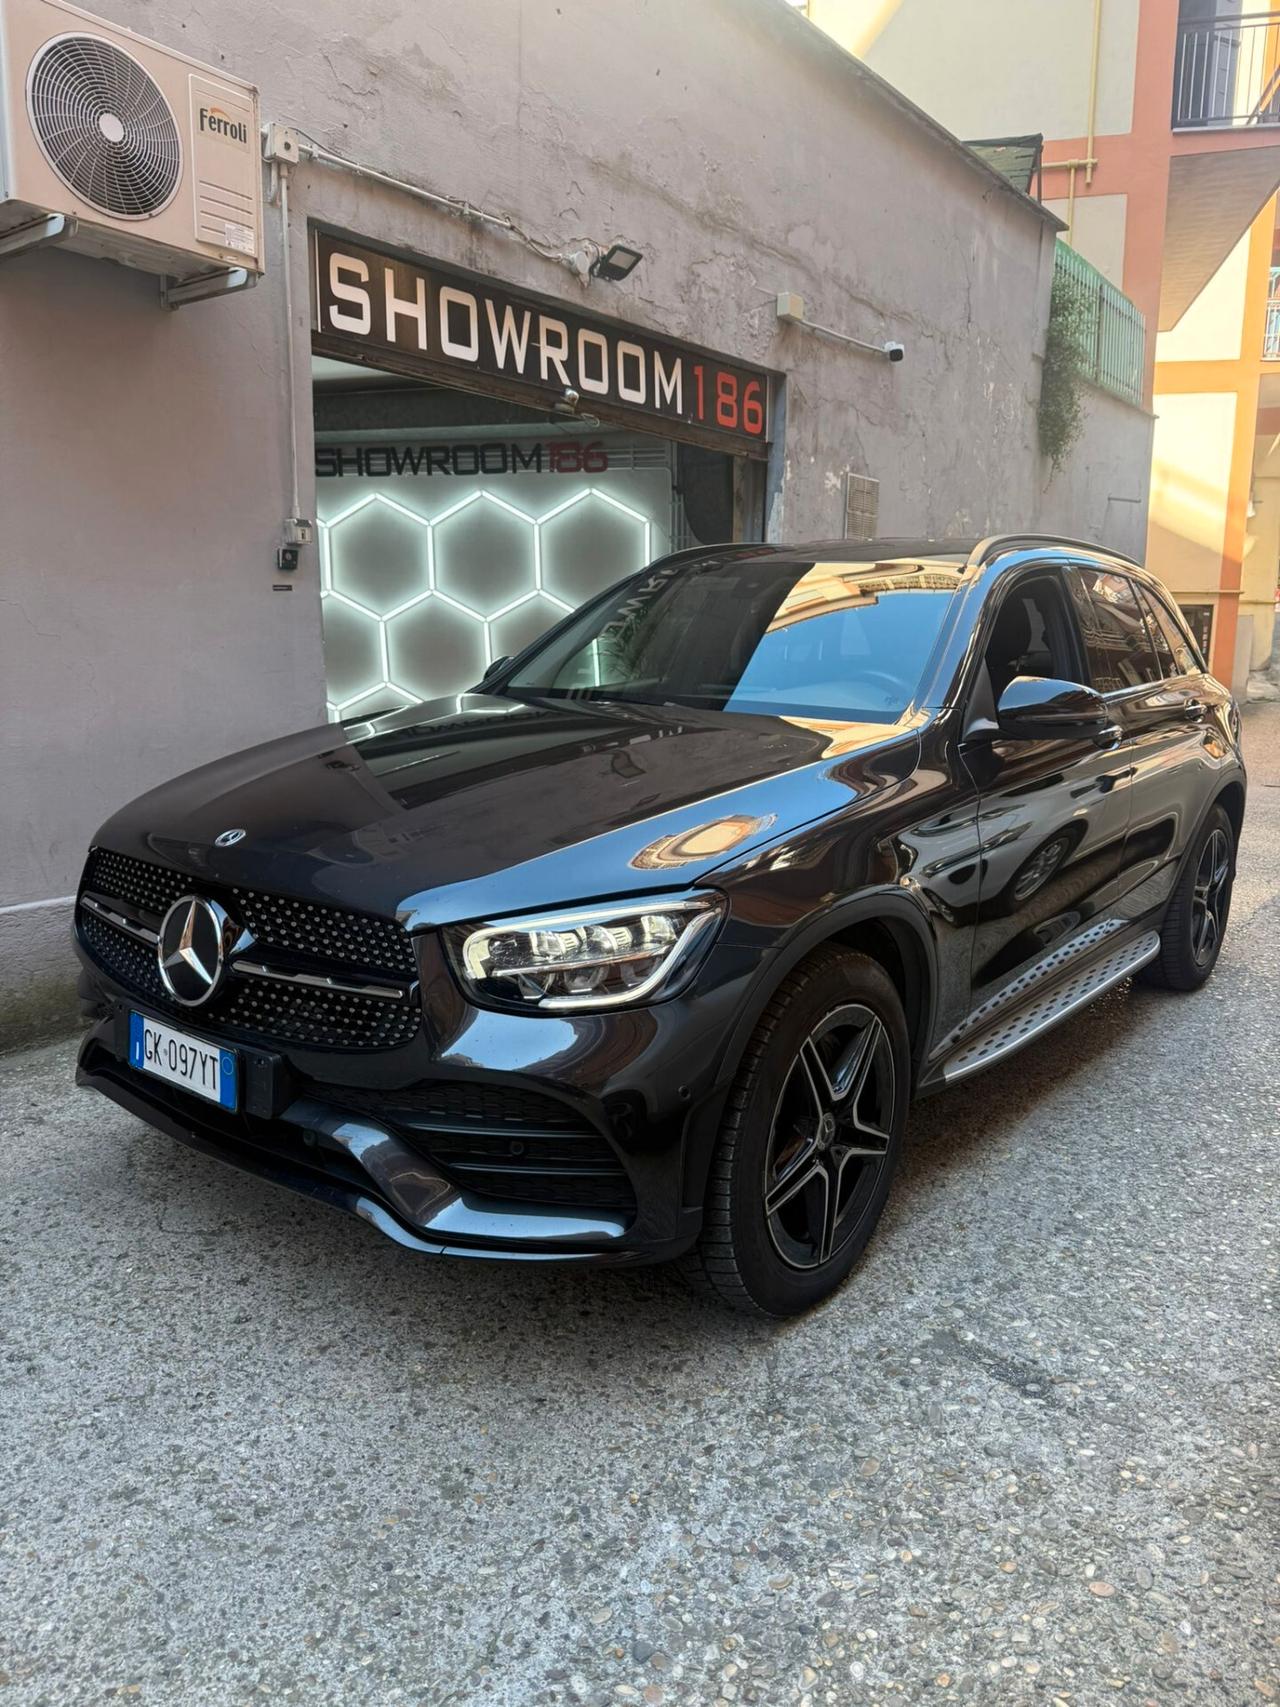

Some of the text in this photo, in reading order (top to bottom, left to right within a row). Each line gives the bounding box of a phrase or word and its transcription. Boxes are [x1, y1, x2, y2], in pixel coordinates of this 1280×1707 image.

[199, 107, 247, 144] Ferroli
[144, 1028, 162, 1067] GK
[168, 1038, 219, 1091] 097YT
